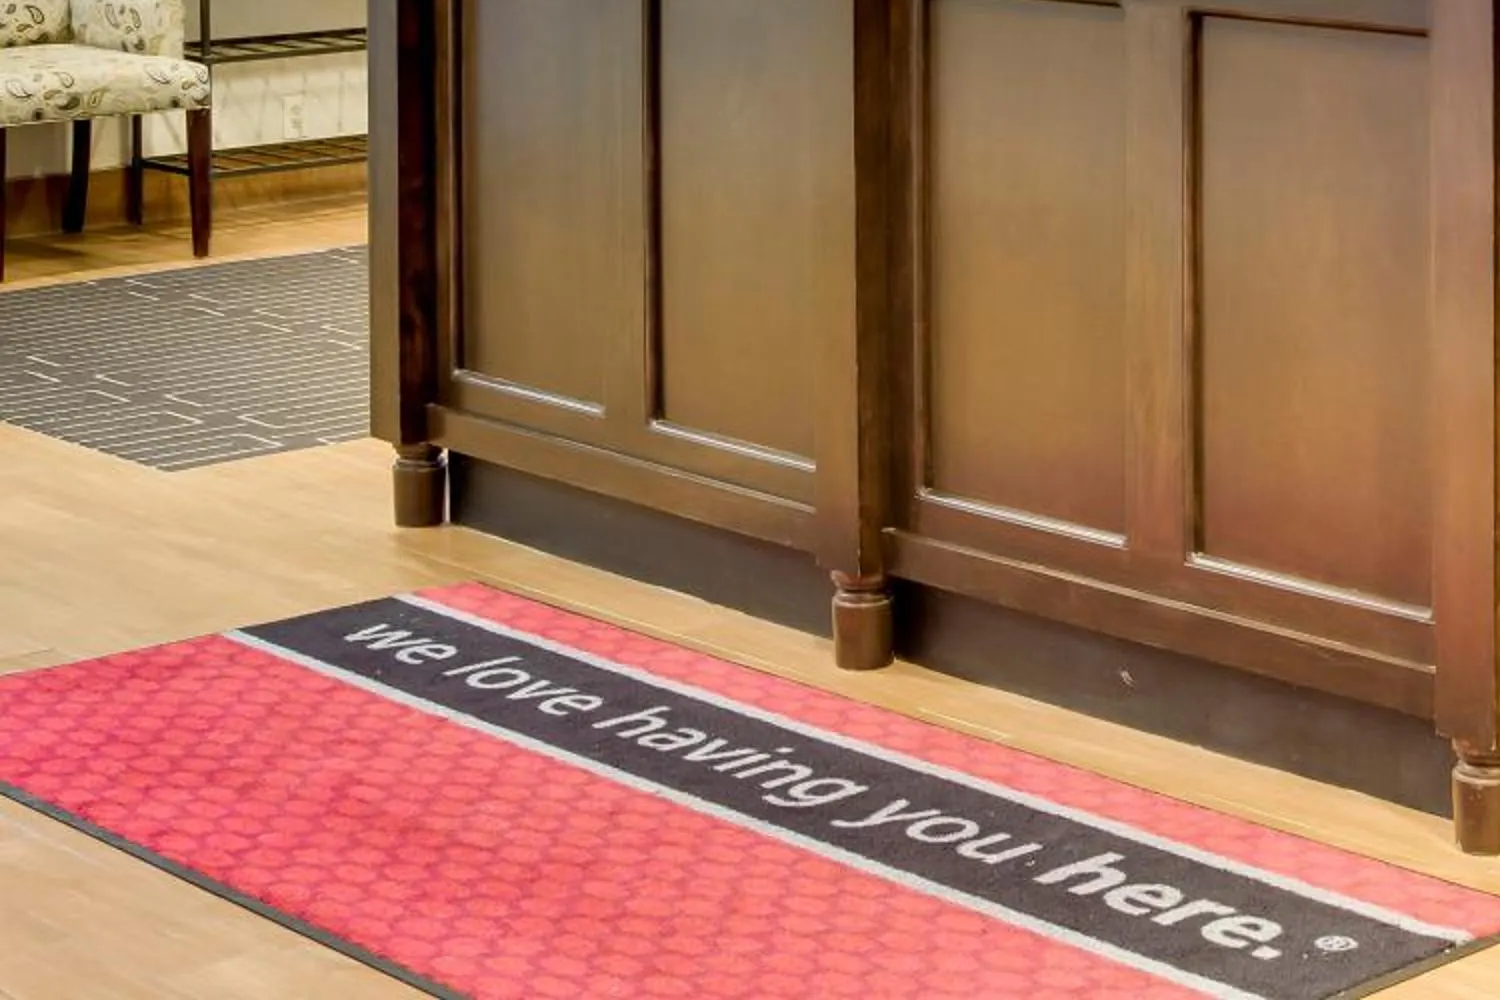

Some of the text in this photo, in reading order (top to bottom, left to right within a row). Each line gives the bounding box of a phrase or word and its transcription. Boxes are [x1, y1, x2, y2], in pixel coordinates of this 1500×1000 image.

[343, 623, 458, 665] we
[442, 655, 605, 717] love
[592, 705, 869, 808] having
[829, 798, 1042, 866] you
[1032, 851, 1284, 961] here.
